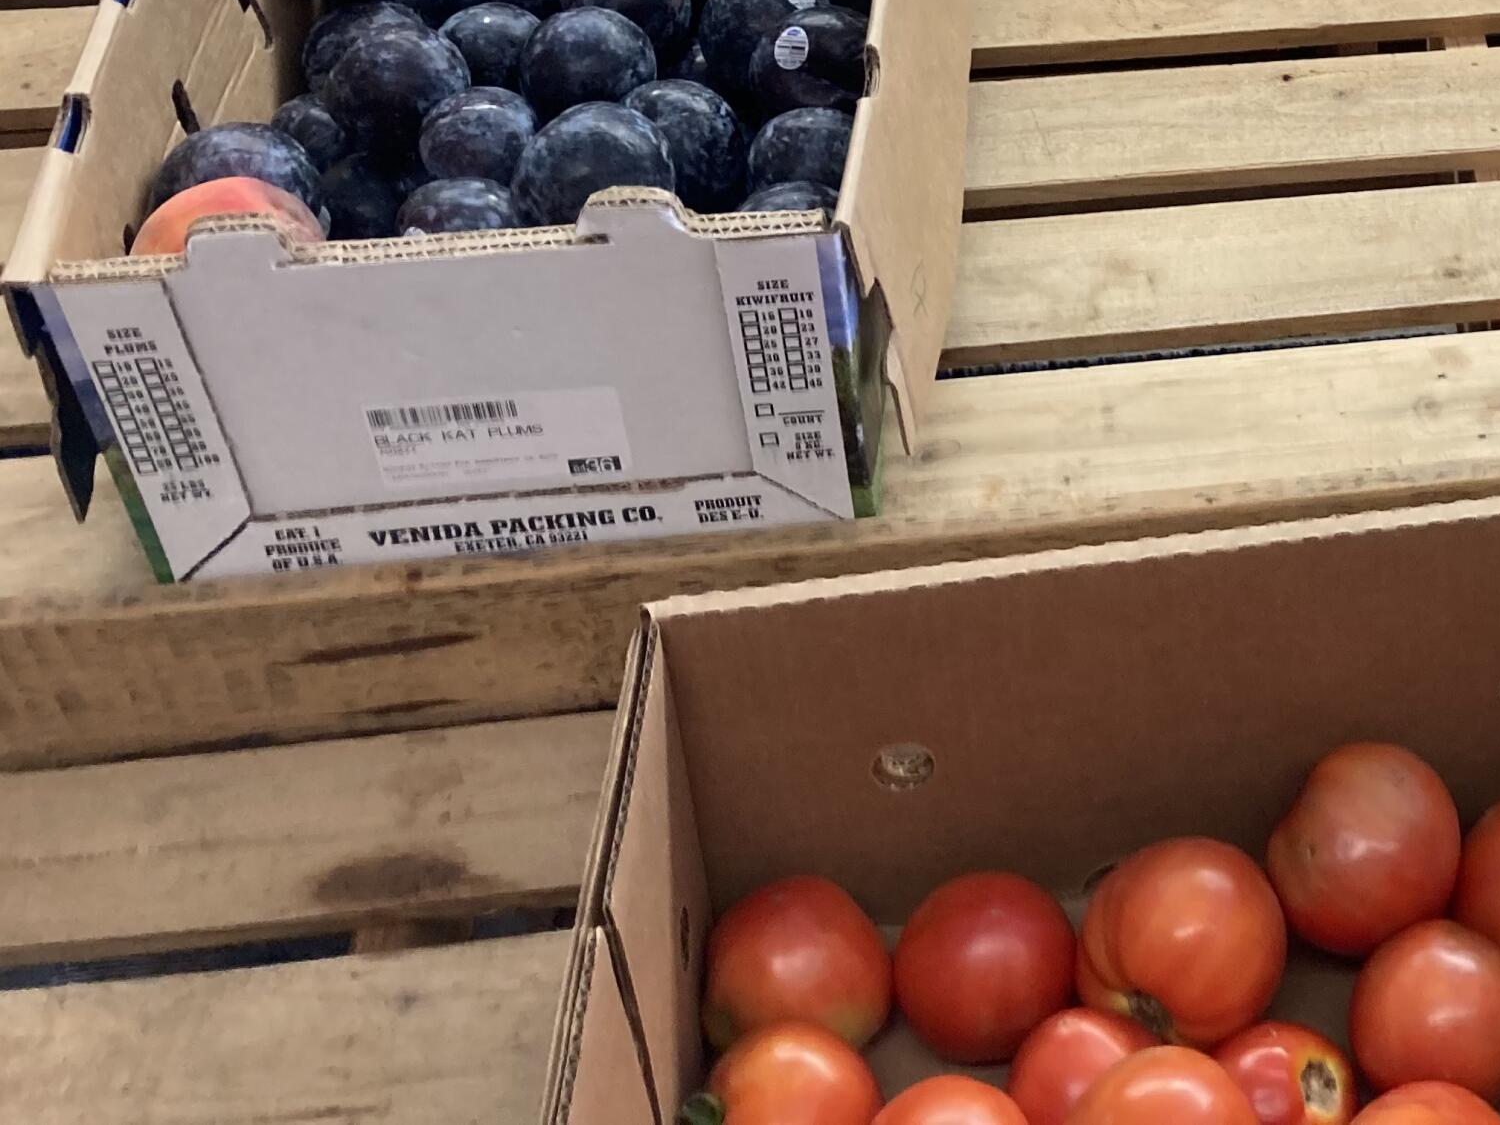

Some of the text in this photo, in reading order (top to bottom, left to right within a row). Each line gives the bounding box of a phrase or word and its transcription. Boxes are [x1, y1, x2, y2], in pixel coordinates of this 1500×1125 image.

[757, 279, 789, 290] SIZE
[736, 292, 814, 306] KIWIFRUIT
[106, 327, 142, 340] SIZE
[104, 340, 158, 355] PLUMS
[805, 337, 818, 346] 27
[782, 415, 823, 426] COUNT
[374, 424, 543, 448] BLACK KAT PLUMS
[694, 495, 762, 511] PRODUIT
[698, 510, 728, 523] DES
[368, 505, 663, 547] VENIDA PACKING CO.
[525, 532, 546, 546] CA
[265, 538, 342, 557] PRODUCE
[272, 557, 292, 572] OF
